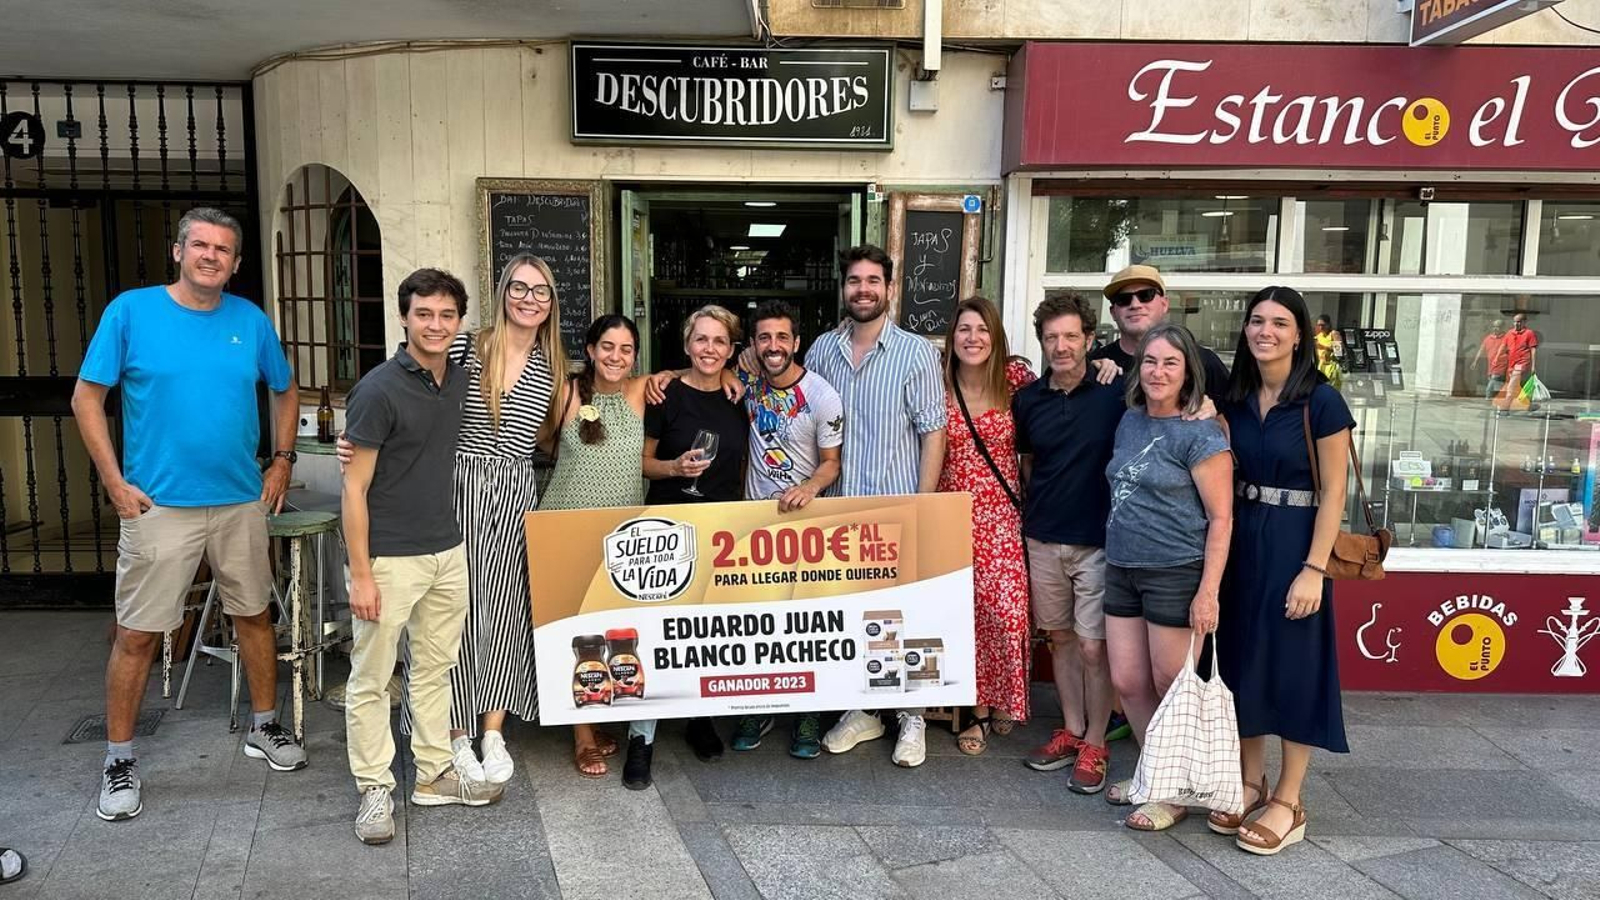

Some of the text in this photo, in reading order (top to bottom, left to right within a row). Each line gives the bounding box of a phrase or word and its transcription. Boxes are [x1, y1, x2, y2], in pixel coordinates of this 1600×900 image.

[692, 53, 728, 69] CAFÉ
[740, 57, 769, 69] BAR
[595, 72, 869, 125] DESCUBRIDORES
[1469, 75, 1531, 147] el
[8, 119, 33, 155] 4
[1425, 131, 1432, 141] EL
[1432, 114, 1442, 141] PUNTO
[911, 228, 952, 253] TAPAS
[1150, 246, 1196, 256] HUELVA
[630, 526, 641, 538] EL
[859, 522, 883, 542] AL
[615, 533, 679, 559] SUELDO
[859, 542, 898, 562] MES
[629, 552, 675, 566] PARA TODA
[622, 568, 635, 582] LA
[715, 566, 897, 586] PARA LLEGAR DONDE QUIERAS
[1427, 594, 1519, 627] BEBIDAS
[663, 610, 844, 640] EDUARDO JUAN
[654, 638, 856, 670] BLANCO PACHECO
[1480, 636, 1492, 671] PUNTO
[1469, 661, 1478, 671] EL
[708, 676, 807, 693] GANADOR 2023
